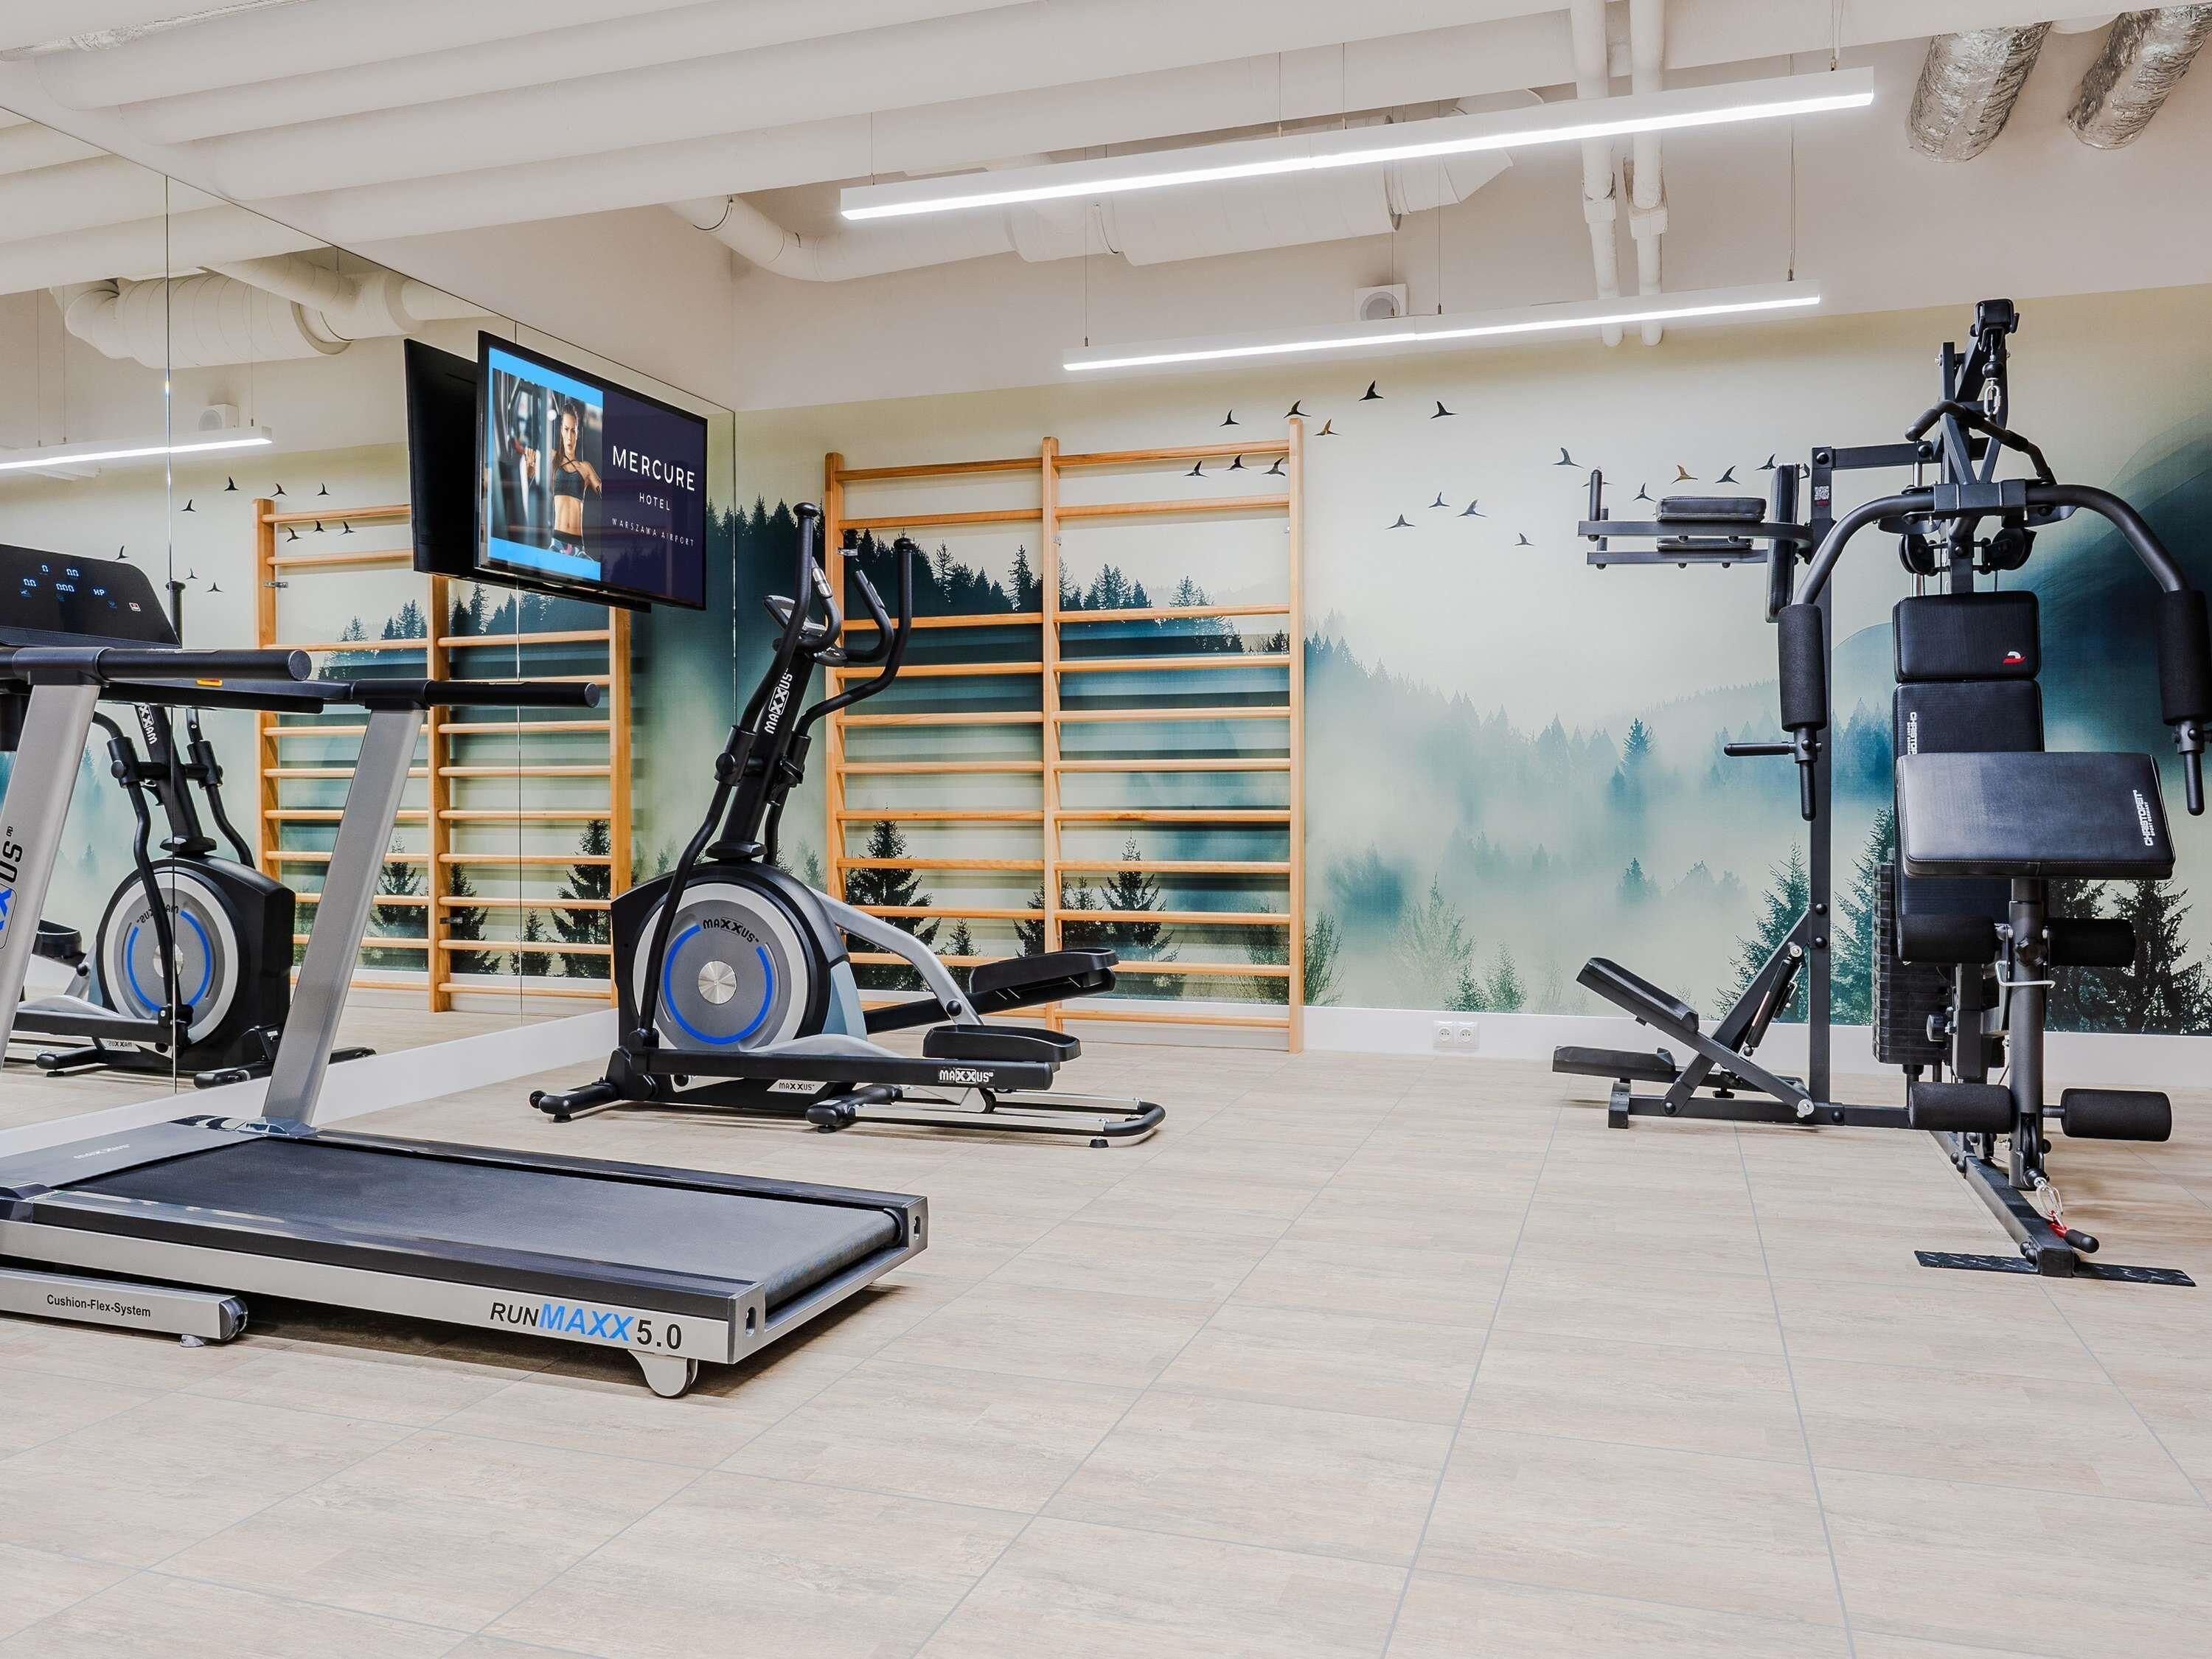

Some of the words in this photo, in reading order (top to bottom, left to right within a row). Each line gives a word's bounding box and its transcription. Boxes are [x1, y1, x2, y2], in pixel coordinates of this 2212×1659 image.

[613, 445, 695, 491] MERCURE
[639, 492, 670, 511] HOTEL
[612, 518, 656, 537] WARSZAWA
[661, 532, 694, 546] AIRPORT
[764, 672, 793, 734] MAXXUS
[2132, 790, 2154, 846] CHRISTOPEIT
[703, 917, 756, 942] MAXXUS
[779, 1082, 813, 1091] MAXXUS
[939, 1068, 990, 1084] MAXXUS
[46, 1294, 151, 1317] Cushion-Flex-System
[636, 1319, 682, 1350] 5.0
